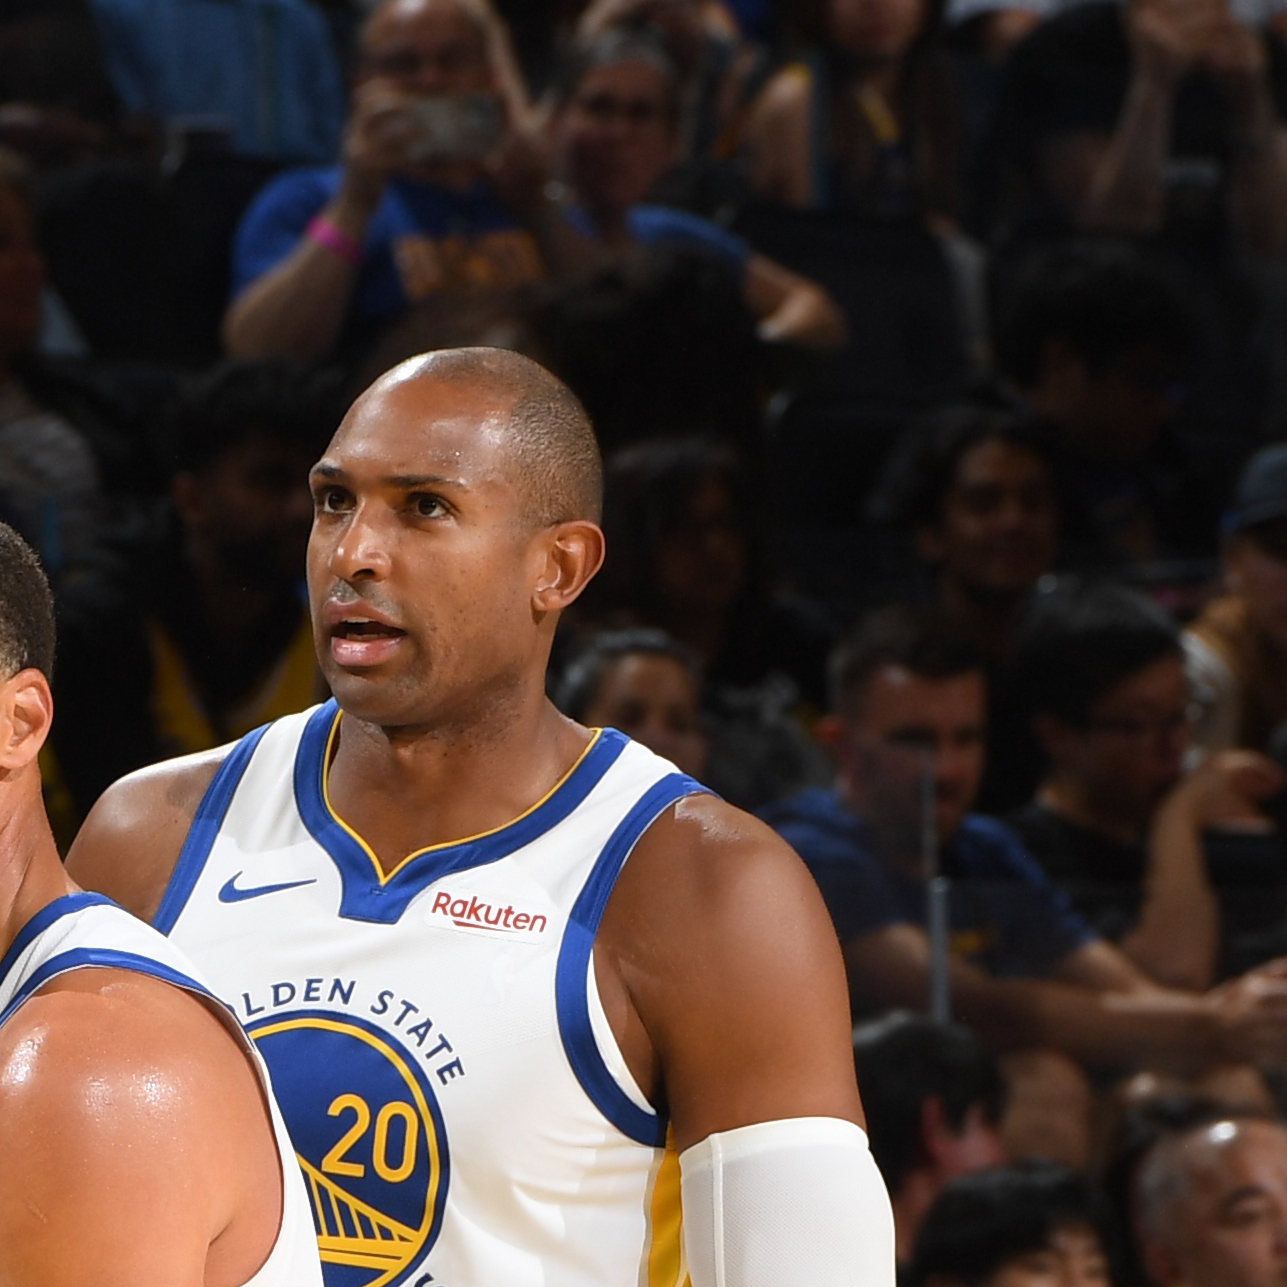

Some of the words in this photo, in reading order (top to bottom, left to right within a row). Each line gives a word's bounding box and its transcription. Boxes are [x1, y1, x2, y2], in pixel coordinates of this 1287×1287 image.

[431, 891, 547, 933] Rakuten
[225, 977, 357, 1017] LDEN
[370, 989, 466, 1086] STATE
[321, 1093, 419, 1184] 20
